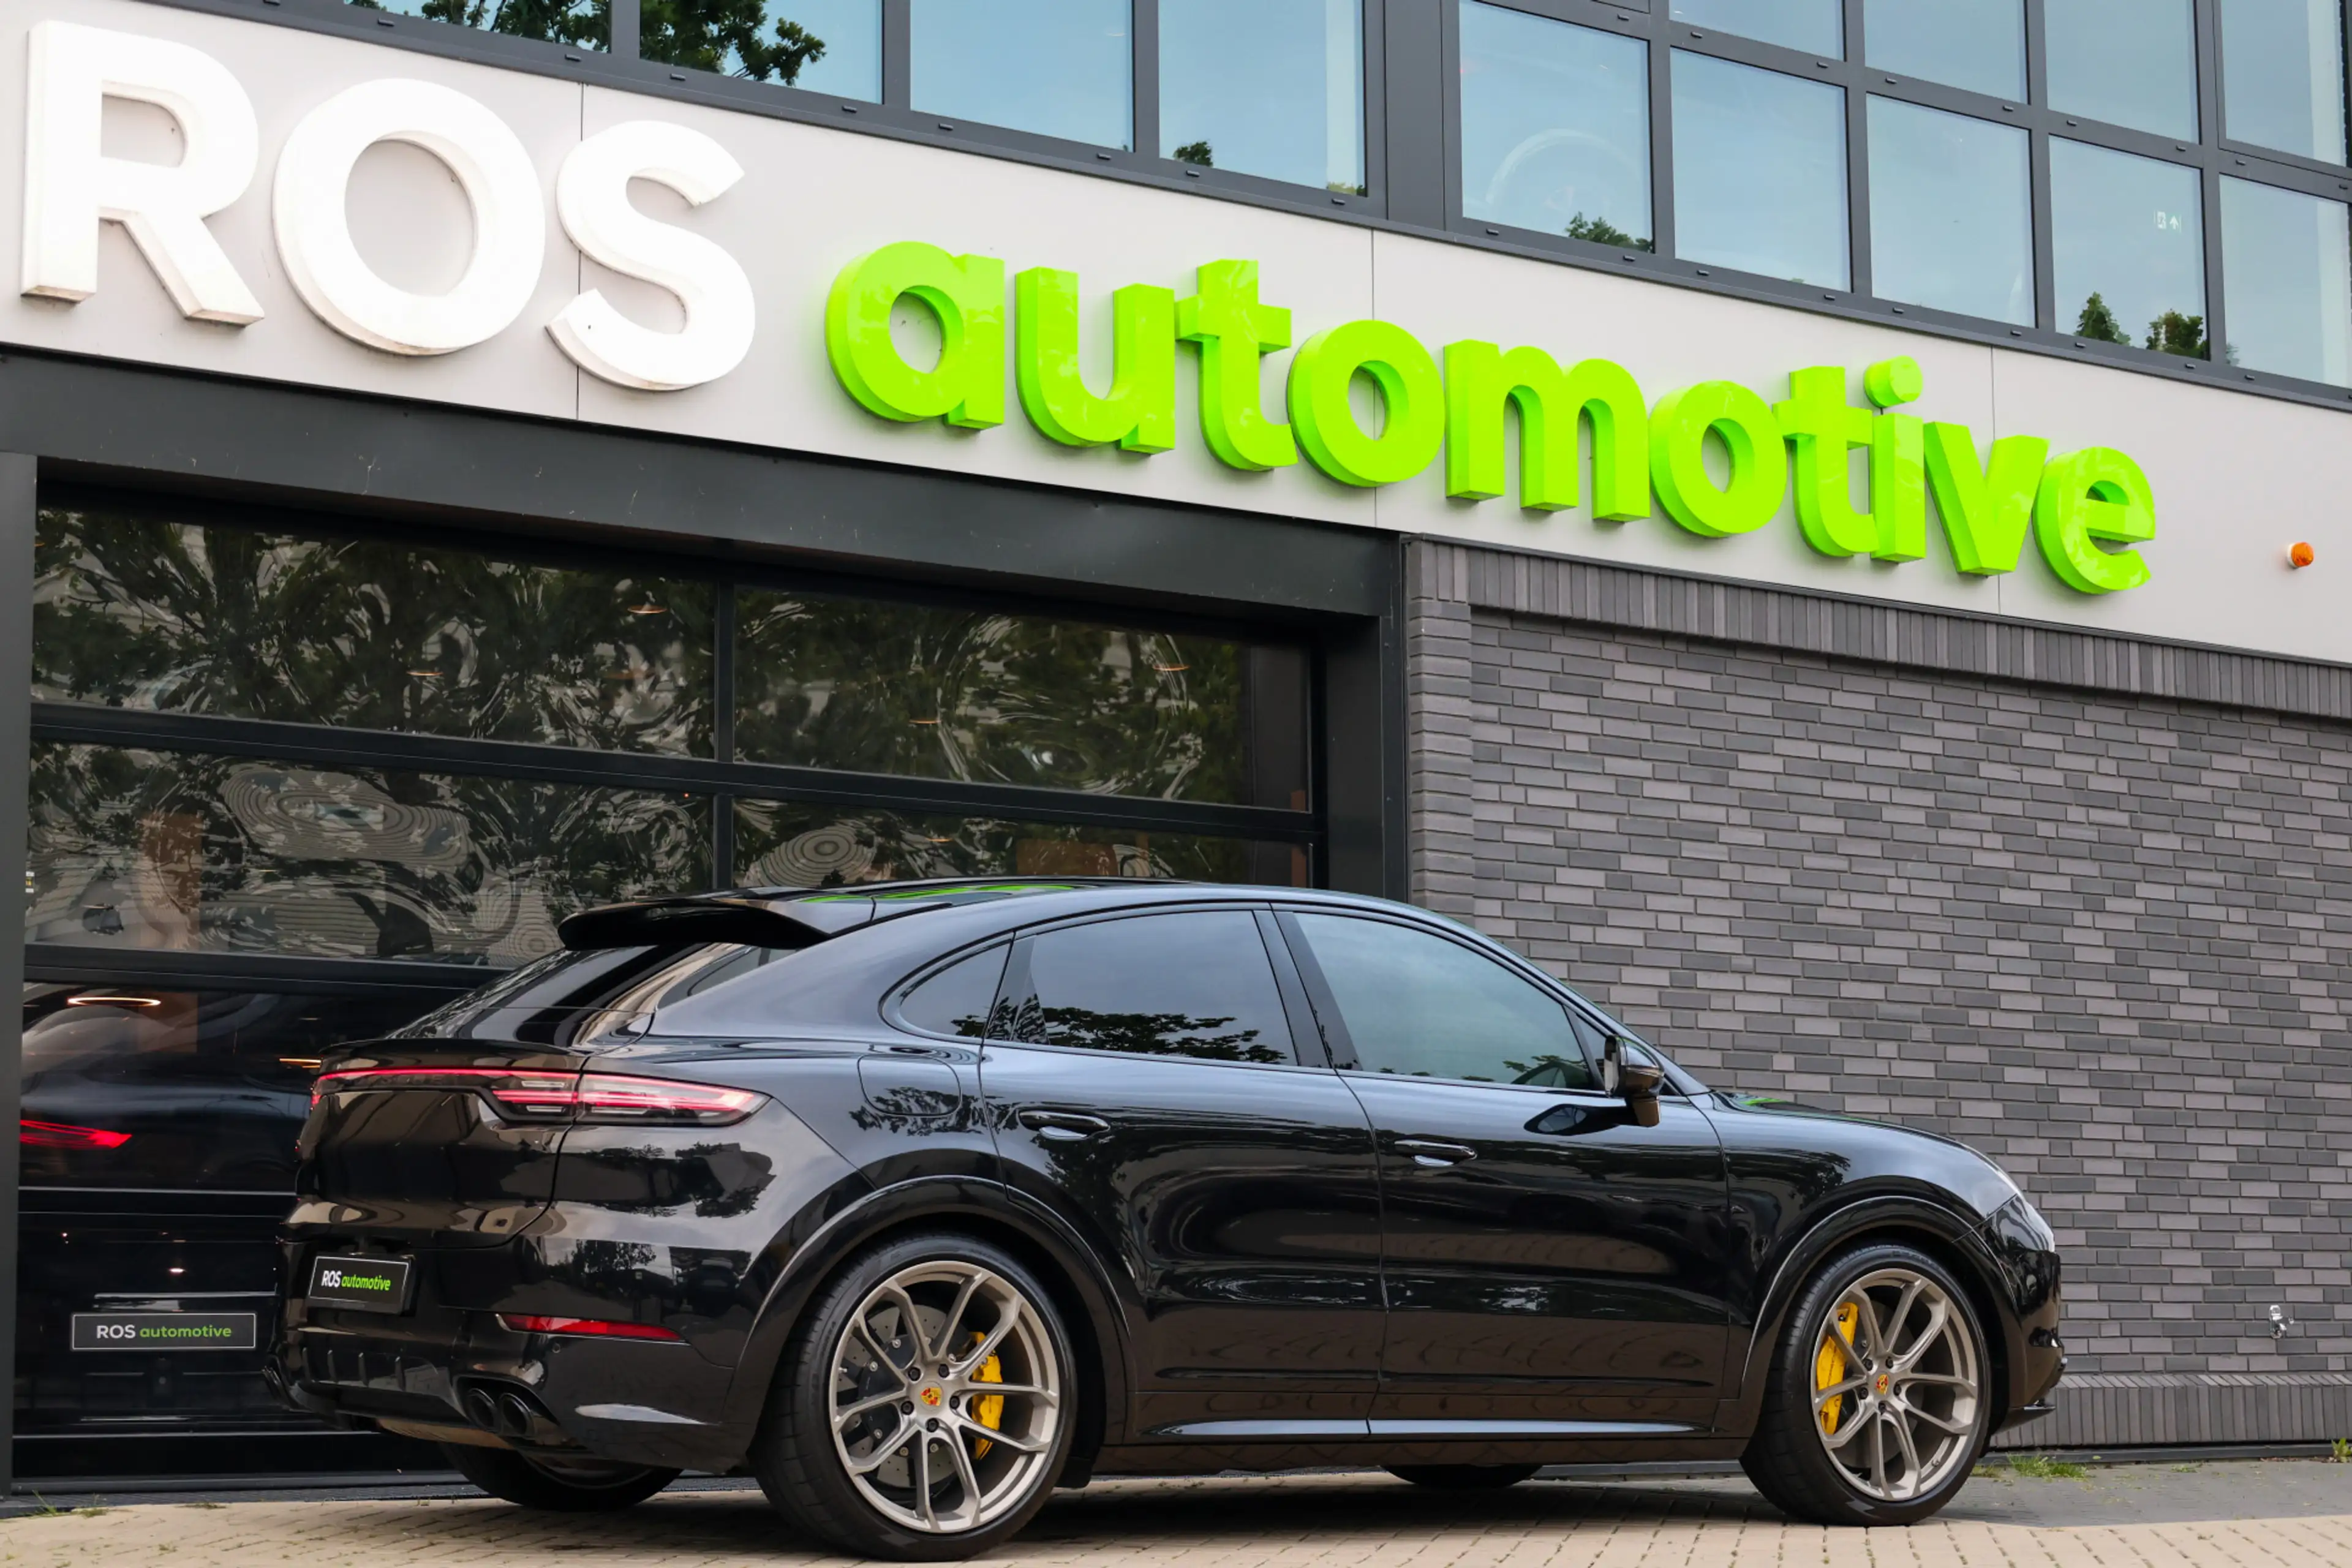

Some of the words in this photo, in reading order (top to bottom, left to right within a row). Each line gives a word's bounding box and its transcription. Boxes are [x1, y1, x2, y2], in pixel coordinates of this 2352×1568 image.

[21, 19, 756, 393] ROS
[824, 240, 2157, 595] automotive
[321, 1270, 342, 1289] ROS
[341, 1274, 391, 1291] automotive
[96, 1324, 136, 1339] ROS
[139, 1325, 232, 1338] automotive
